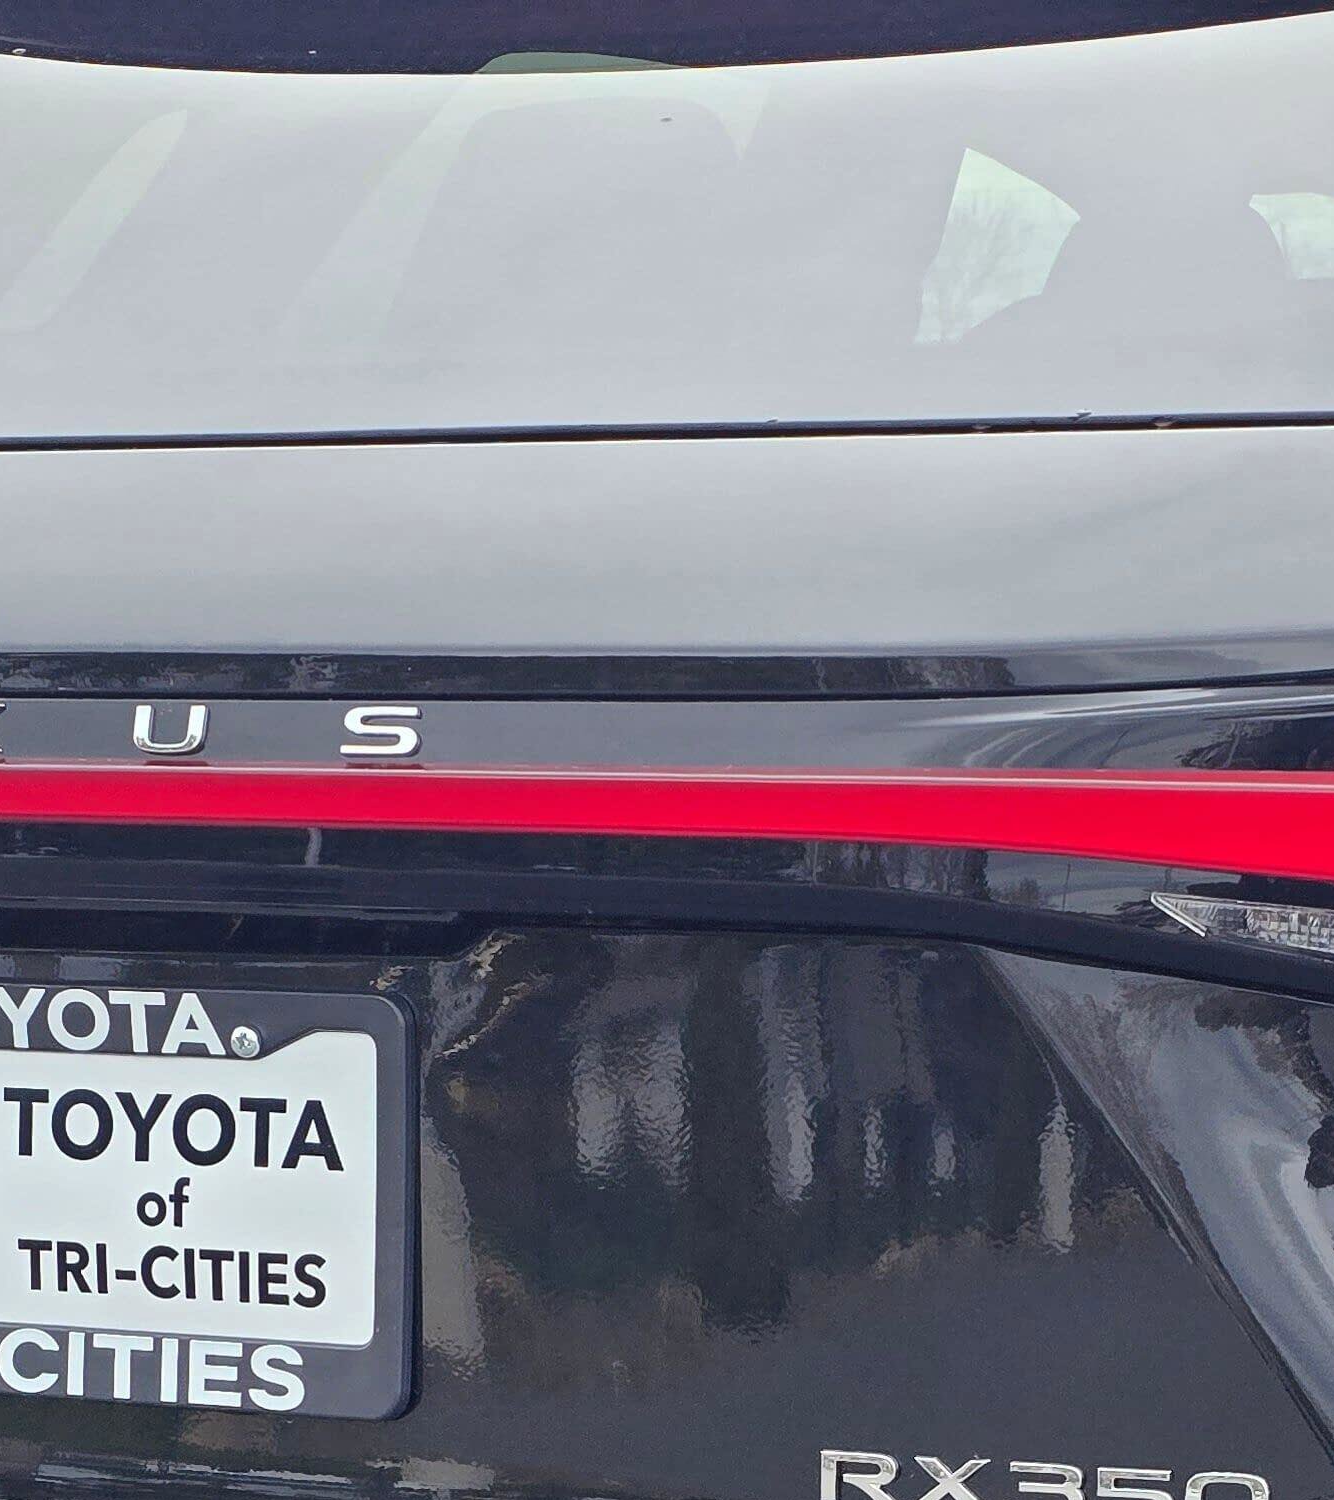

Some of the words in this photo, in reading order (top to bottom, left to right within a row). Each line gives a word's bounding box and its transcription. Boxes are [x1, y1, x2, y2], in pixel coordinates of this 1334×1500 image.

[3, 1086, 344, 1172] TOYOTA
[135, 1176, 190, 1229] of
[17, 1238, 327, 1309] TRI-CITIES
